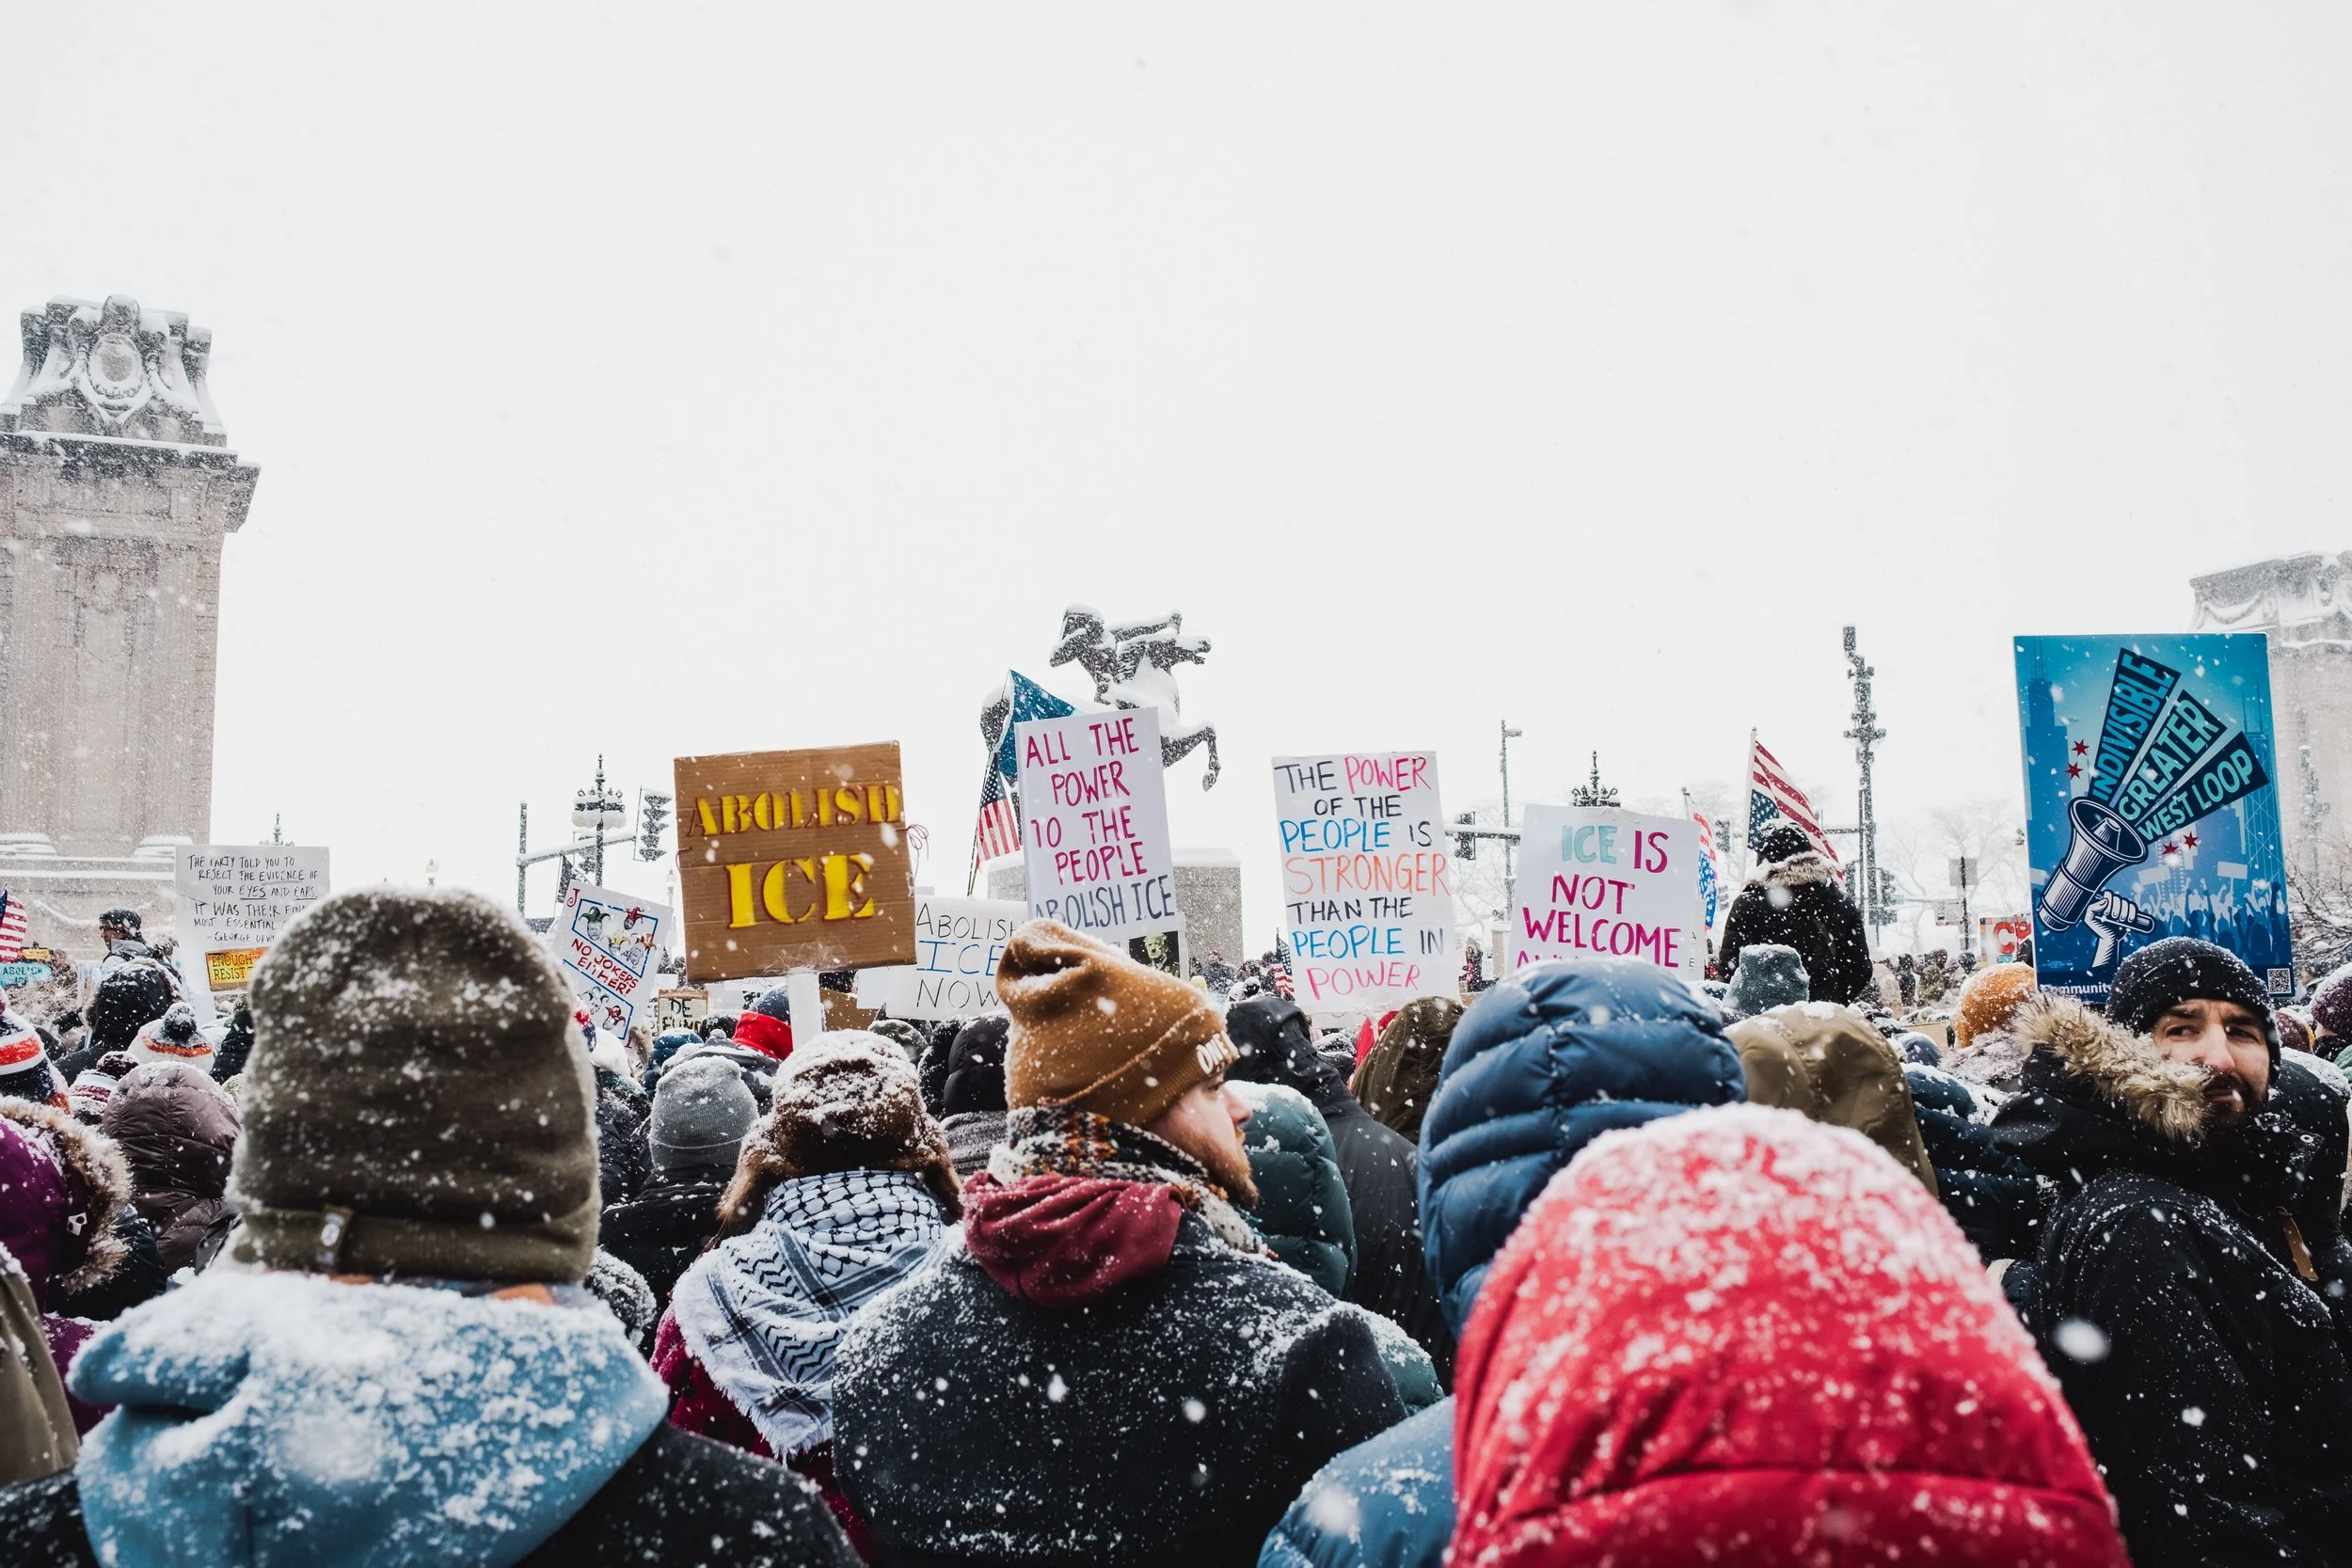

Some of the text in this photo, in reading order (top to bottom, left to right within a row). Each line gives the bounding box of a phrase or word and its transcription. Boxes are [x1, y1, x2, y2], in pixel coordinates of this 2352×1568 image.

[1026, 717, 1139, 768] ALL THE
[2092, 655, 2175, 800] INDIVISIBLE
[1274, 755, 1432, 795] THE POWER
[2119, 699, 2219, 820] GREATER
[1051, 760, 1130, 807] POWER
[2137, 749, 2253, 840] WEST LOOP
[687, 784, 900, 836] ABOLISH
[1313, 795, 1402, 819] OF THE
[1031, 805, 1136, 848] TO THE
[1279, 817, 1432, 853] PEOPLE IS
[187, 855, 294, 869] THE PARTY TOLD YOU TO
[1055, 841, 1147, 885] PEOPLE
[1562, 825, 1669, 874] ICE IS
[199, 870, 319, 882] REJECT THE EVIDENCE OF
[213, 884, 234, 895] YOUR
[239, 884, 266, 897] EYES
[271, 887, 290, 896] AND
[725, 853, 875, 928] ICE
[1285, 853, 1451, 895] STRONGER
[195, 902, 309, 918] IT WAS THEIR FINA
[566, 888, 580, 908] J
[1131, 874, 1175, 921] ICE
[1286, 896, 1413, 925] THAN THE
[1551, 873, 1635, 914] NOT
[194, 917, 216, 927] MOST
[226, 917, 278, 930] ESSENTIAL
[215, 931, 250, 942] GEORGE
[1292, 925, 1405, 958] PEOPLE
[1420, 927, 1444, 956] IN
[1522, 907, 1681, 968] WELCOME
[2, 966, 42, 975] ABOLISH
[212, 954, 253, 967] ENOUGH
[214, 967, 246, 980] RESIST
[571, 938, 592, 957] NO
[595, 954, 639, 989] JOKERS
[916, 941, 1005, 975] ICE
[916, 978, 999, 1008] NOW
[1306, 960, 1421, 1000] POWER
[669, 999, 692, 1019] DE
